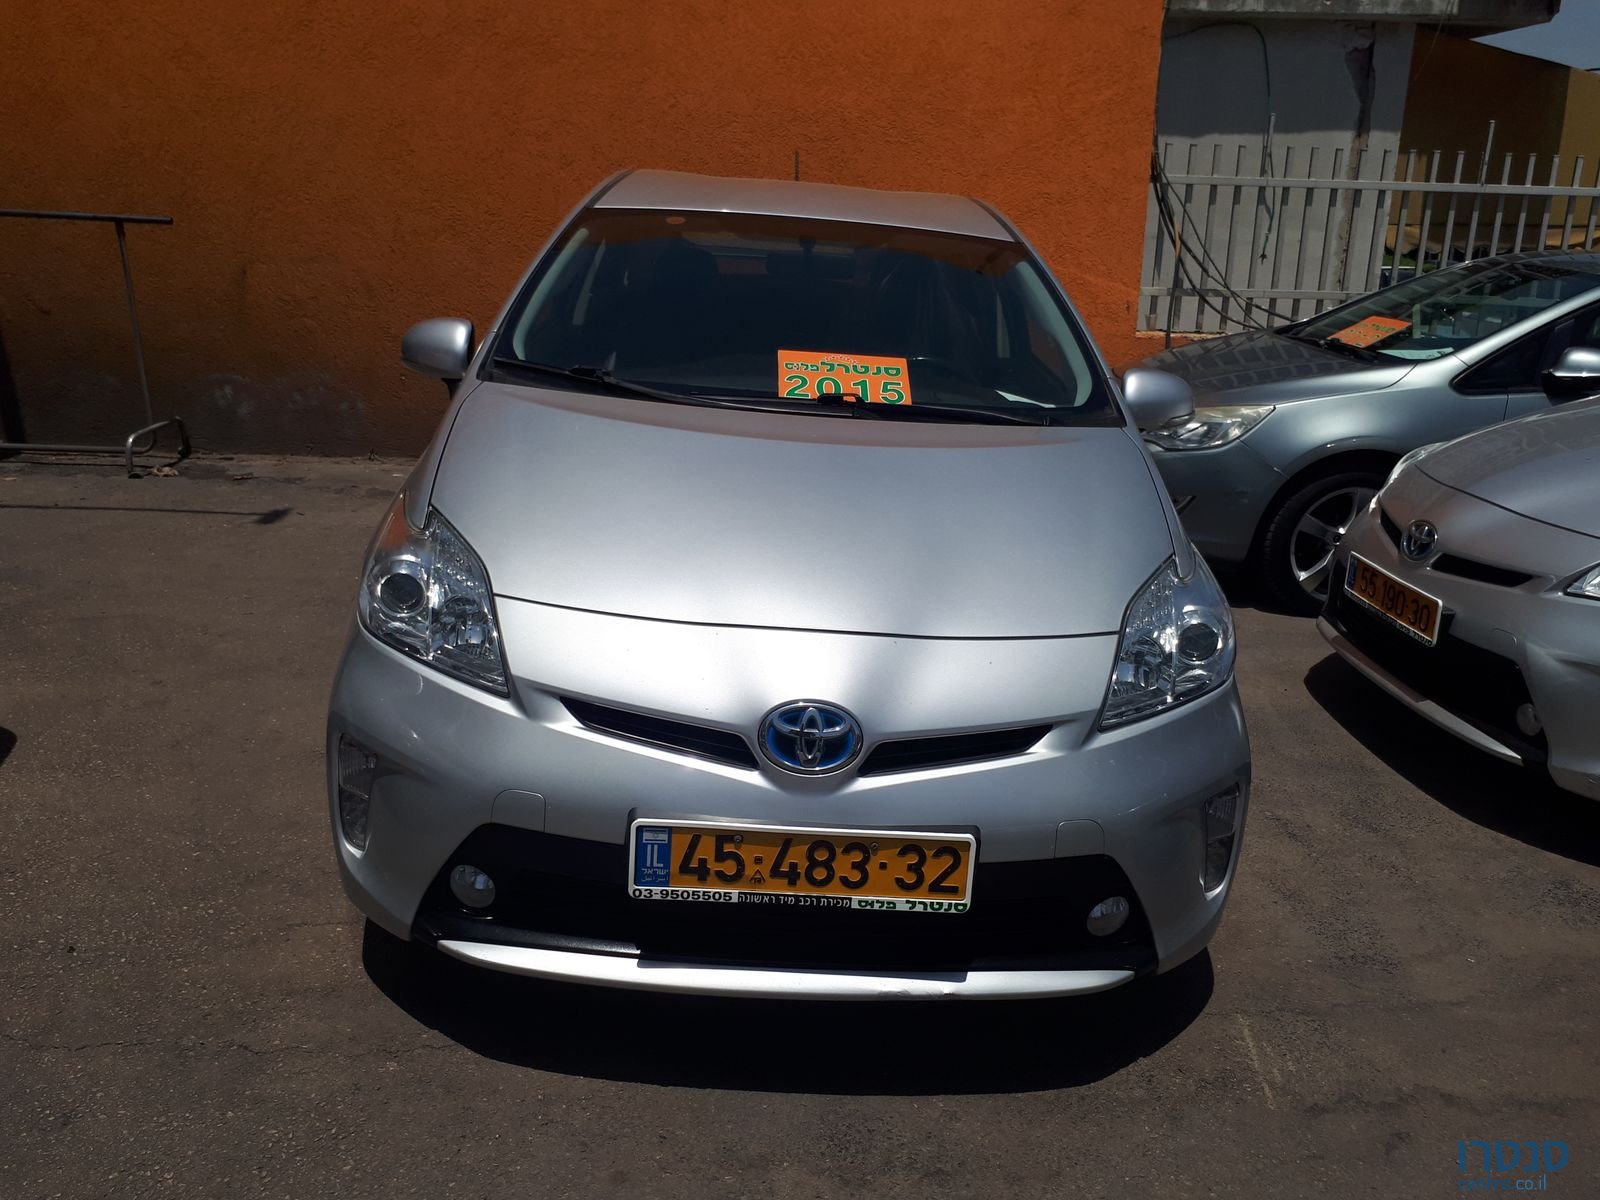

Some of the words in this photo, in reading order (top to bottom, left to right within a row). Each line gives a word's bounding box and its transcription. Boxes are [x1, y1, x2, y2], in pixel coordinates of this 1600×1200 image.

[820, 361, 902, 377] סנטרל
[784, 374, 907, 405] 2015
[646, 844, 664, 867] IL
[632, 888, 733, 902] 03-9505505
[738, 893, 776, 904] ראשונה
[778, 895, 795, 905] מיד
[798, 896, 817, 906] רכב
[819, 898, 850, 908] מכירת
[905, 899, 968, 913] סנטרל
